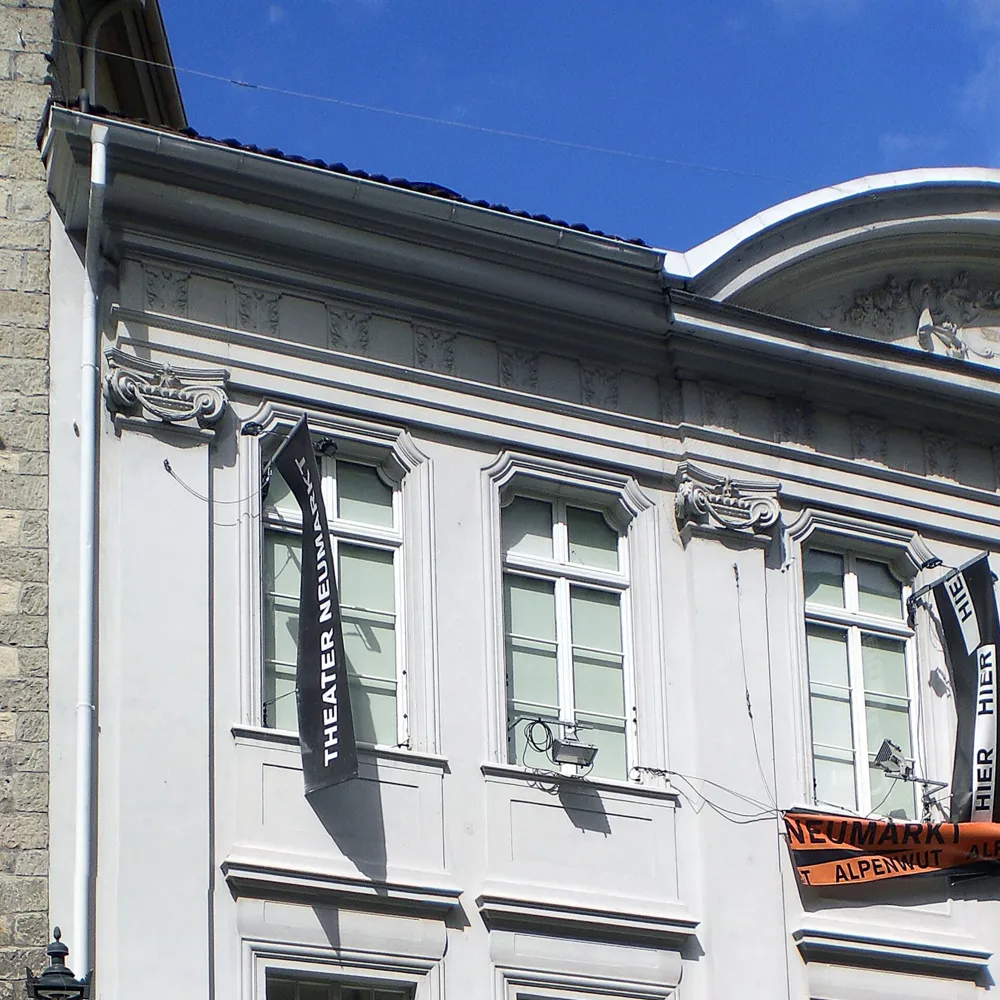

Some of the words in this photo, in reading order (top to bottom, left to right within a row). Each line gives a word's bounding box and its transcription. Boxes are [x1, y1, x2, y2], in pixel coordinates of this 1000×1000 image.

[295, 456, 334, 622] NEUMARKT
[946, 573, 972, 623] HIE
[319, 628, 338, 767] THEATER
[978, 651, 994, 716] HIER
[975, 748, 993, 811] HIER
[785, 819, 960, 845] NEUMARKT
[835, 849, 943, 883] ALPENWUT
